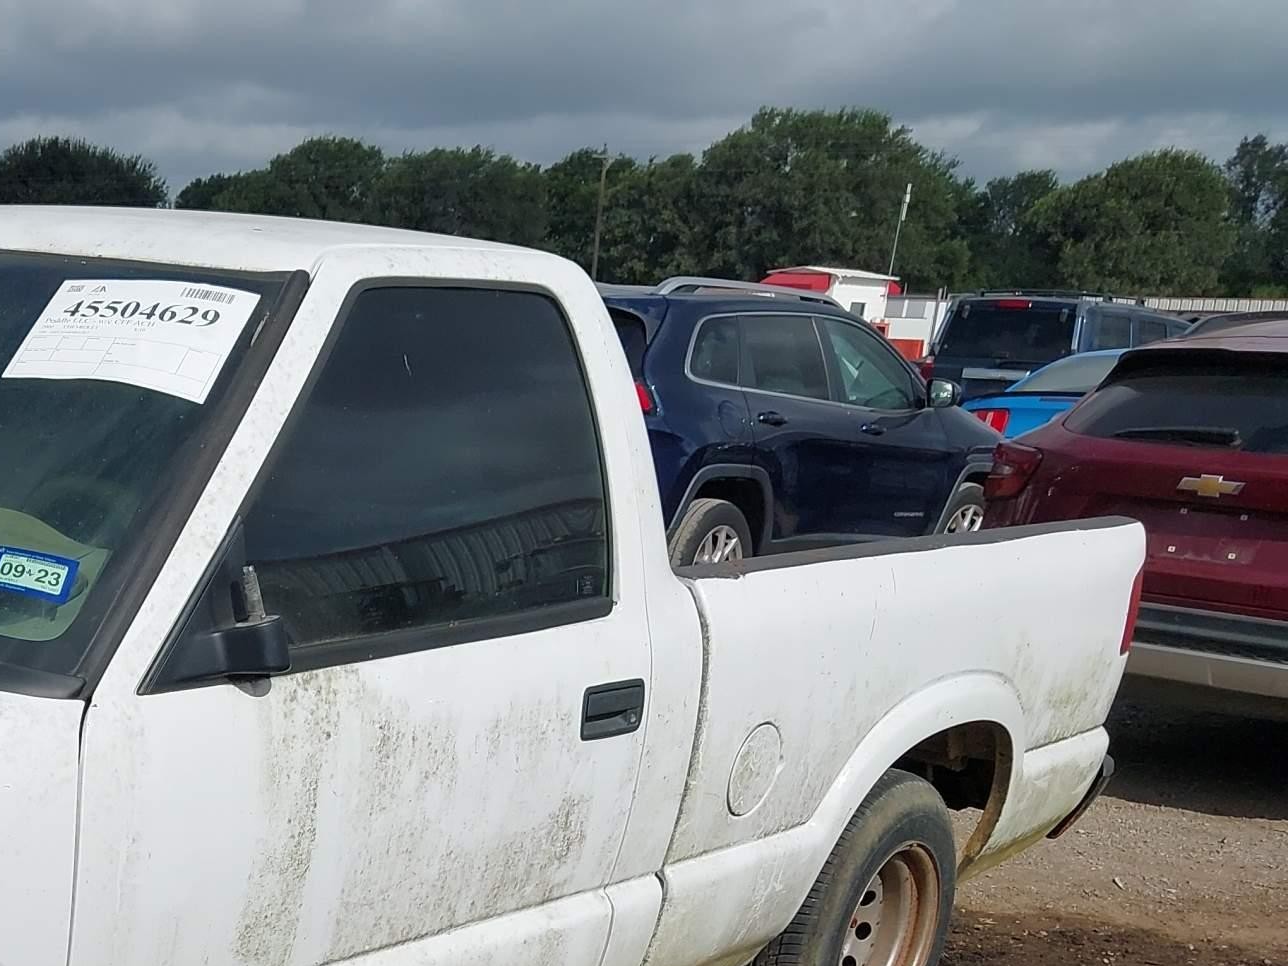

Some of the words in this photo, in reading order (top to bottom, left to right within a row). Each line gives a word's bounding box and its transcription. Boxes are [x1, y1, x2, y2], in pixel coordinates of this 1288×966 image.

[63, 299, 221, 328] 45504629
[0, 562, 26, 578] 09
[34, 568, 62, 587] 23
